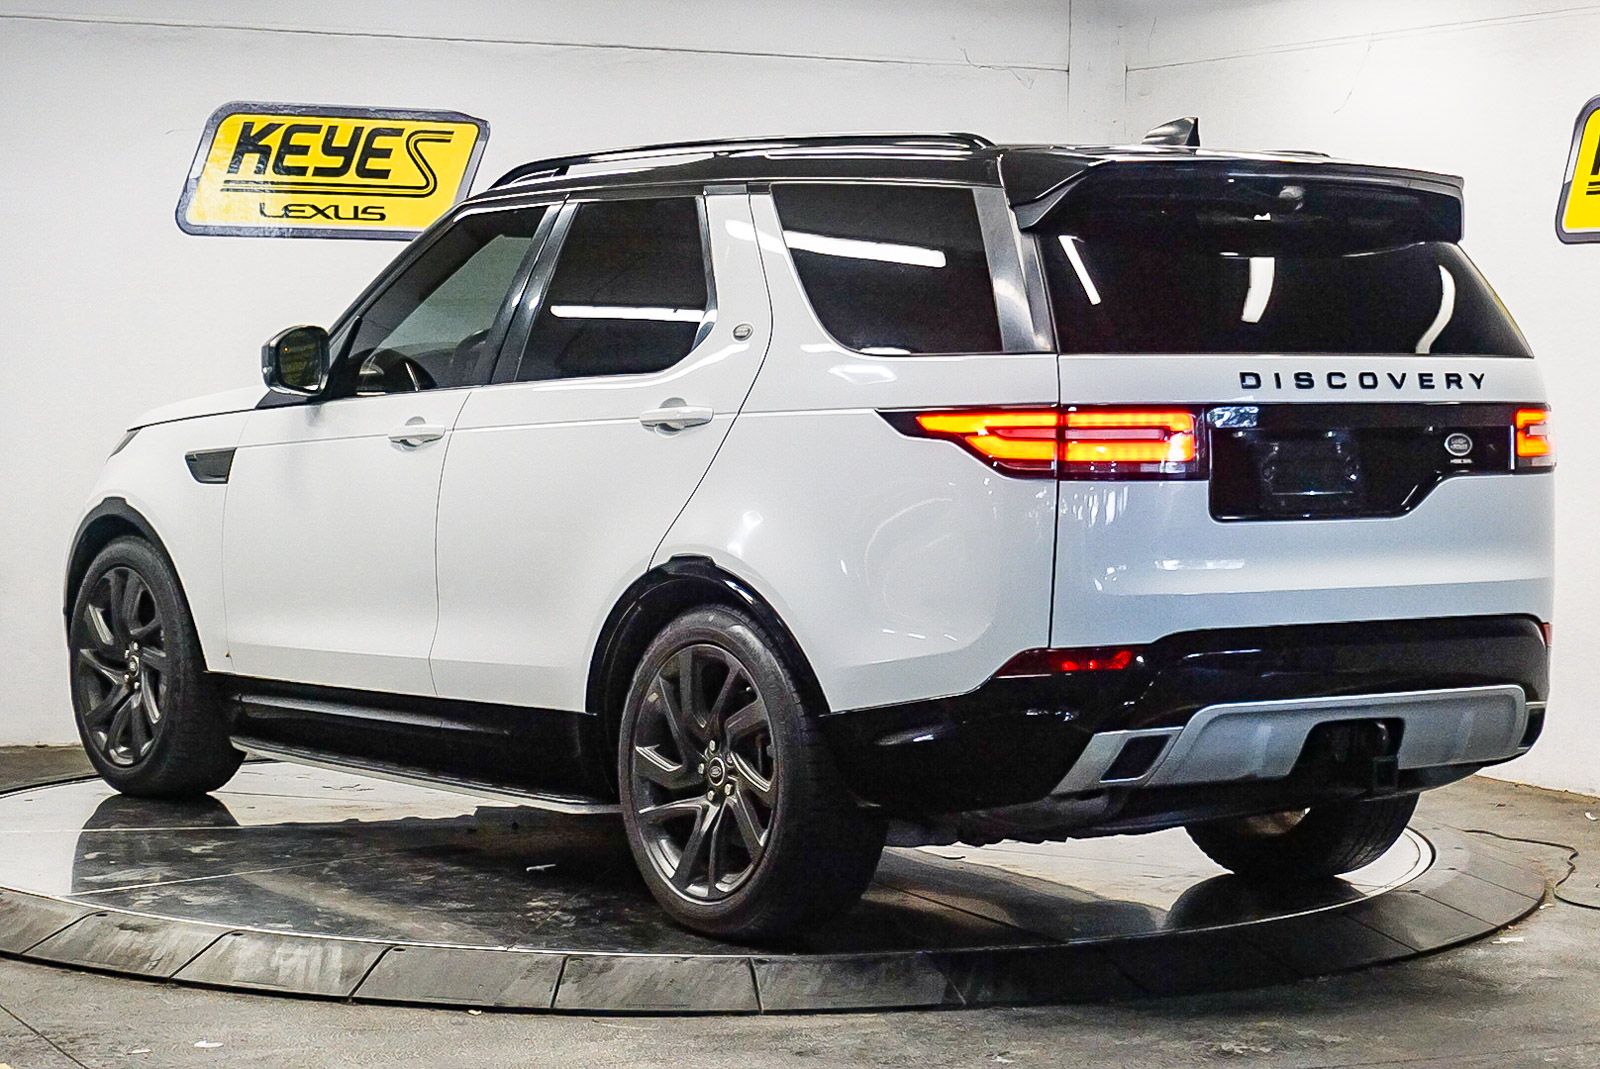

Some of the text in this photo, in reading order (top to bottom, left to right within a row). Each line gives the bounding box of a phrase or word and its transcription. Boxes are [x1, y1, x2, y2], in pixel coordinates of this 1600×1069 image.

[223, 121, 455, 198] KEYES
[259, 203, 386, 222] LEXUS
[1239, 371, 1485, 390] DISCOVERY
